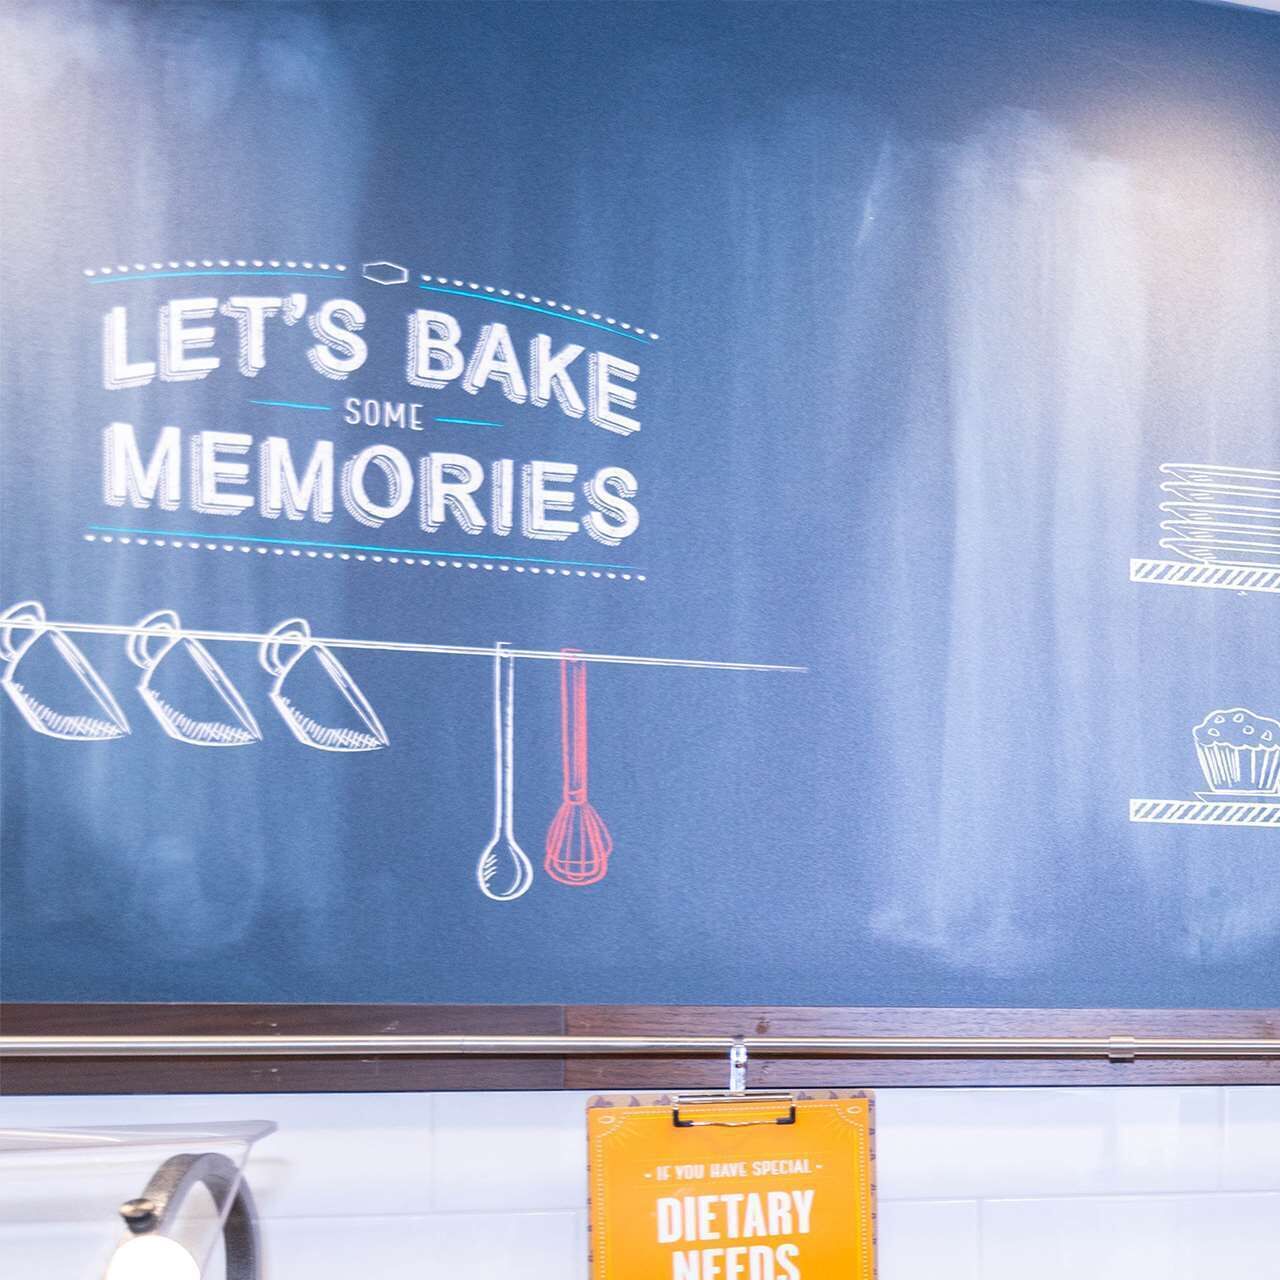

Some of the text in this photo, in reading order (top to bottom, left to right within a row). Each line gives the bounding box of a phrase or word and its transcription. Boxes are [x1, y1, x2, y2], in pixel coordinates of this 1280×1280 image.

[103, 293, 641, 435] LET'S BAKE
[343, 397, 425, 432] SOME
[103, 422, 641, 547] MEMORIES
[656, 1158, 812, 1181] IF YOU HAVE SPECIAL
[655, 1189, 816, 1244] DIETARY
